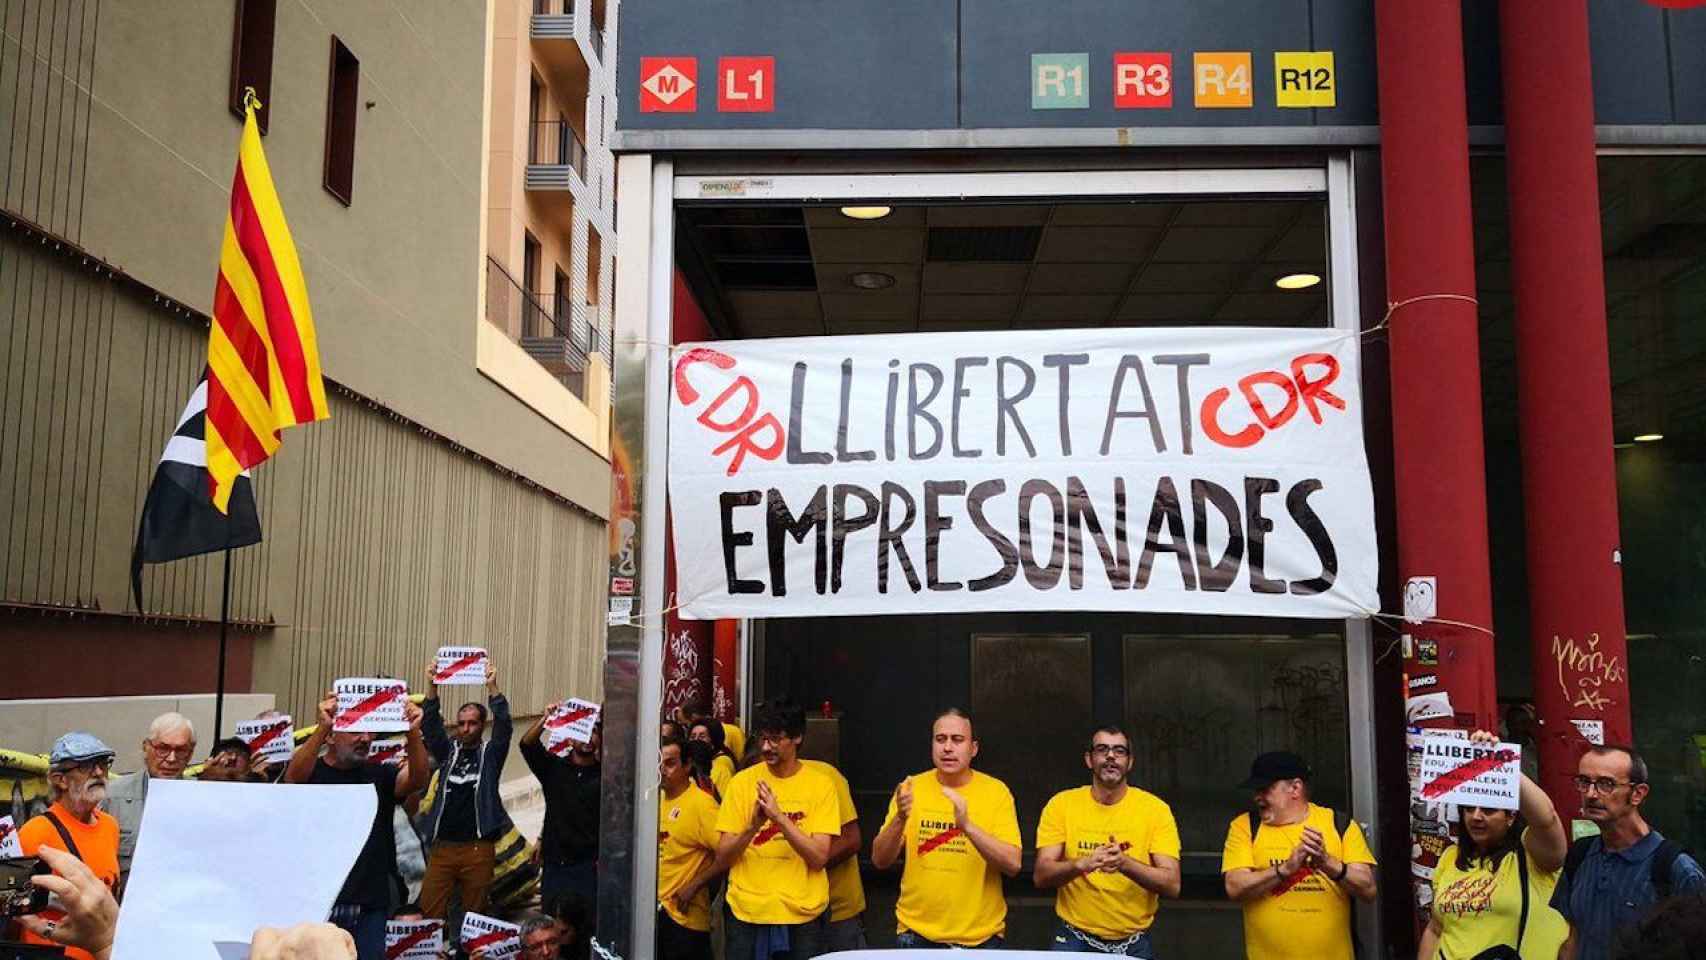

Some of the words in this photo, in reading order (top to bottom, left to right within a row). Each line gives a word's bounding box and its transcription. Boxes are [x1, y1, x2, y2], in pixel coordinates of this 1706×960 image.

[657, 75, 680, 94] M
[725, 69, 765, 101] L1
[1037, 64, 1083, 97] R1
[1116, 63, 1171, 97] R3
[1197, 63, 1250, 97] R4
[1280, 67, 1331, 92] R12
[673, 348, 785, 477] CDR
[1200, 352, 1347, 450] CDR
[719, 475, 1340, 598] EMPRESONADES
